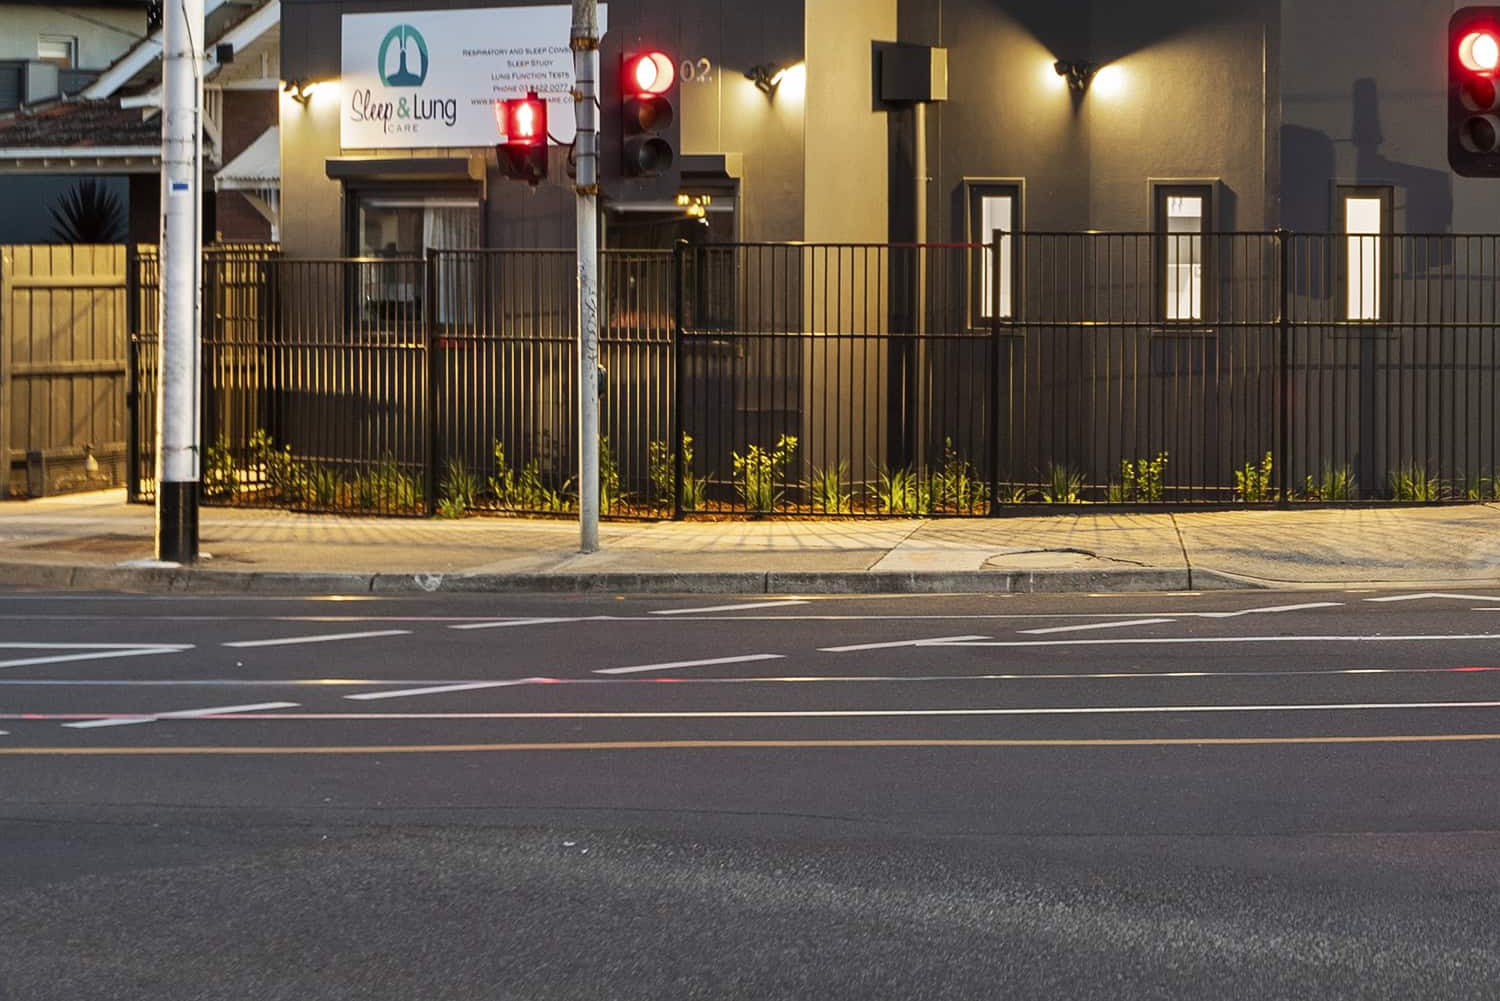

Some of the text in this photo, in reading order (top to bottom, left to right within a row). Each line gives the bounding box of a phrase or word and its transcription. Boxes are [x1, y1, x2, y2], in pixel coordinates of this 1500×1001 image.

[509, 47, 525, 55] AND
[525, 47, 547, 55] SLEEP
[507, 59, 553, 68] SLEEP STUDY
[491, 71, 571, 81] LUNG FUNCTION TESTS
[492, 84, 518, 93] PHONE
[350, 88, 457, 135] Sleep & Lung
[388, 123, 420, 133] CARE
